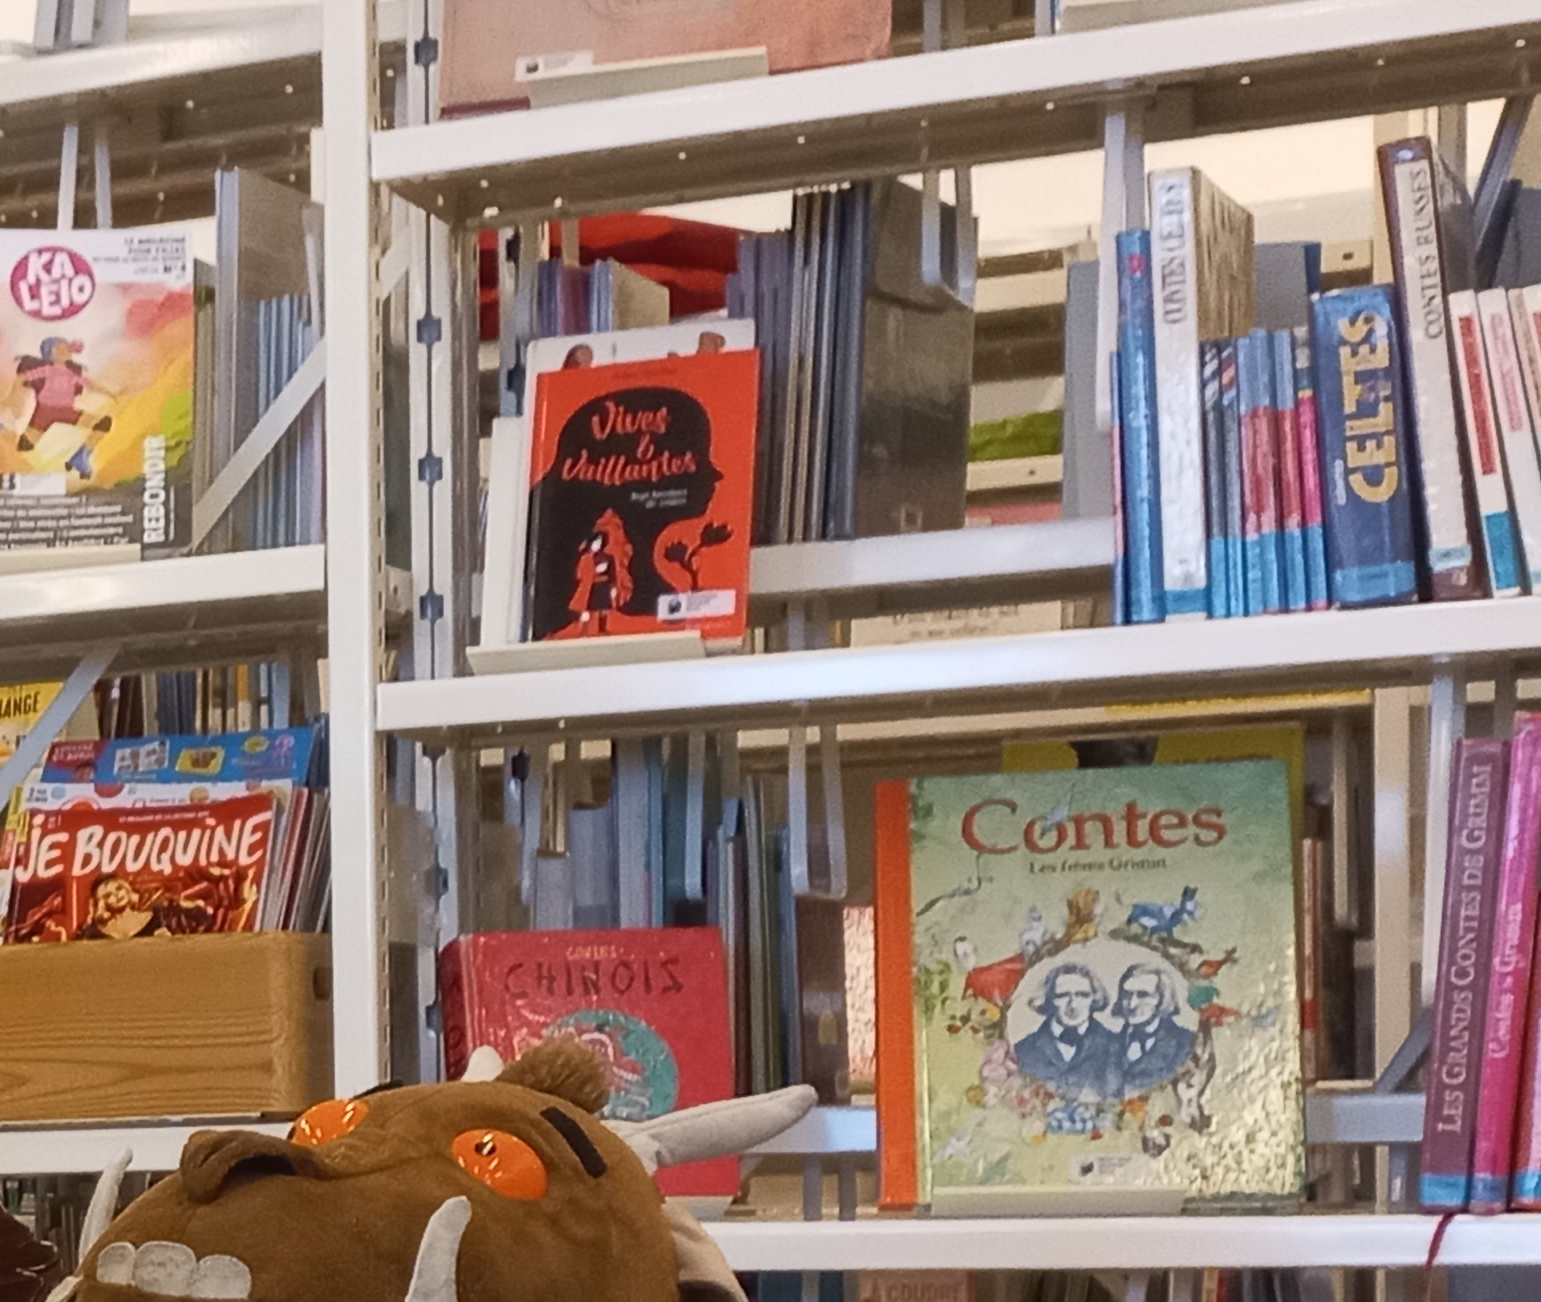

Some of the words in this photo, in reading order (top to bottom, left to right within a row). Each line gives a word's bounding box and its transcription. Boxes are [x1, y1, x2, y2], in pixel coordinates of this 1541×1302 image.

[26, 251, 75, 285] KA
[19, 273, 95, 317] LEIO
[1416, 254, 1446, 342] CONTES
[591, 400, 669, 441] Vives
[1337, 308, 1400, 504] CELTES
[143, 435, 166, 544] REBONDIR
[561, 447, 698, 486] Vaillantes
[960, 797, 1229, 856] Contes
[1461, 762, 1494, 846] GRIMM
[13, 813, 70, 884] JE
[71, 810, 273, 878] BOUQUINE
[1028, 860, 1056, 875] Les
[1462, 852, 1484, 889] DE
[1449, 892, 1482, 989] CONTES
[503, 957, 686, 999] CHINOIS
[1441, 990, 1473, 1086] GRANDS
[1437, 1088, 1464, 1136] LES
